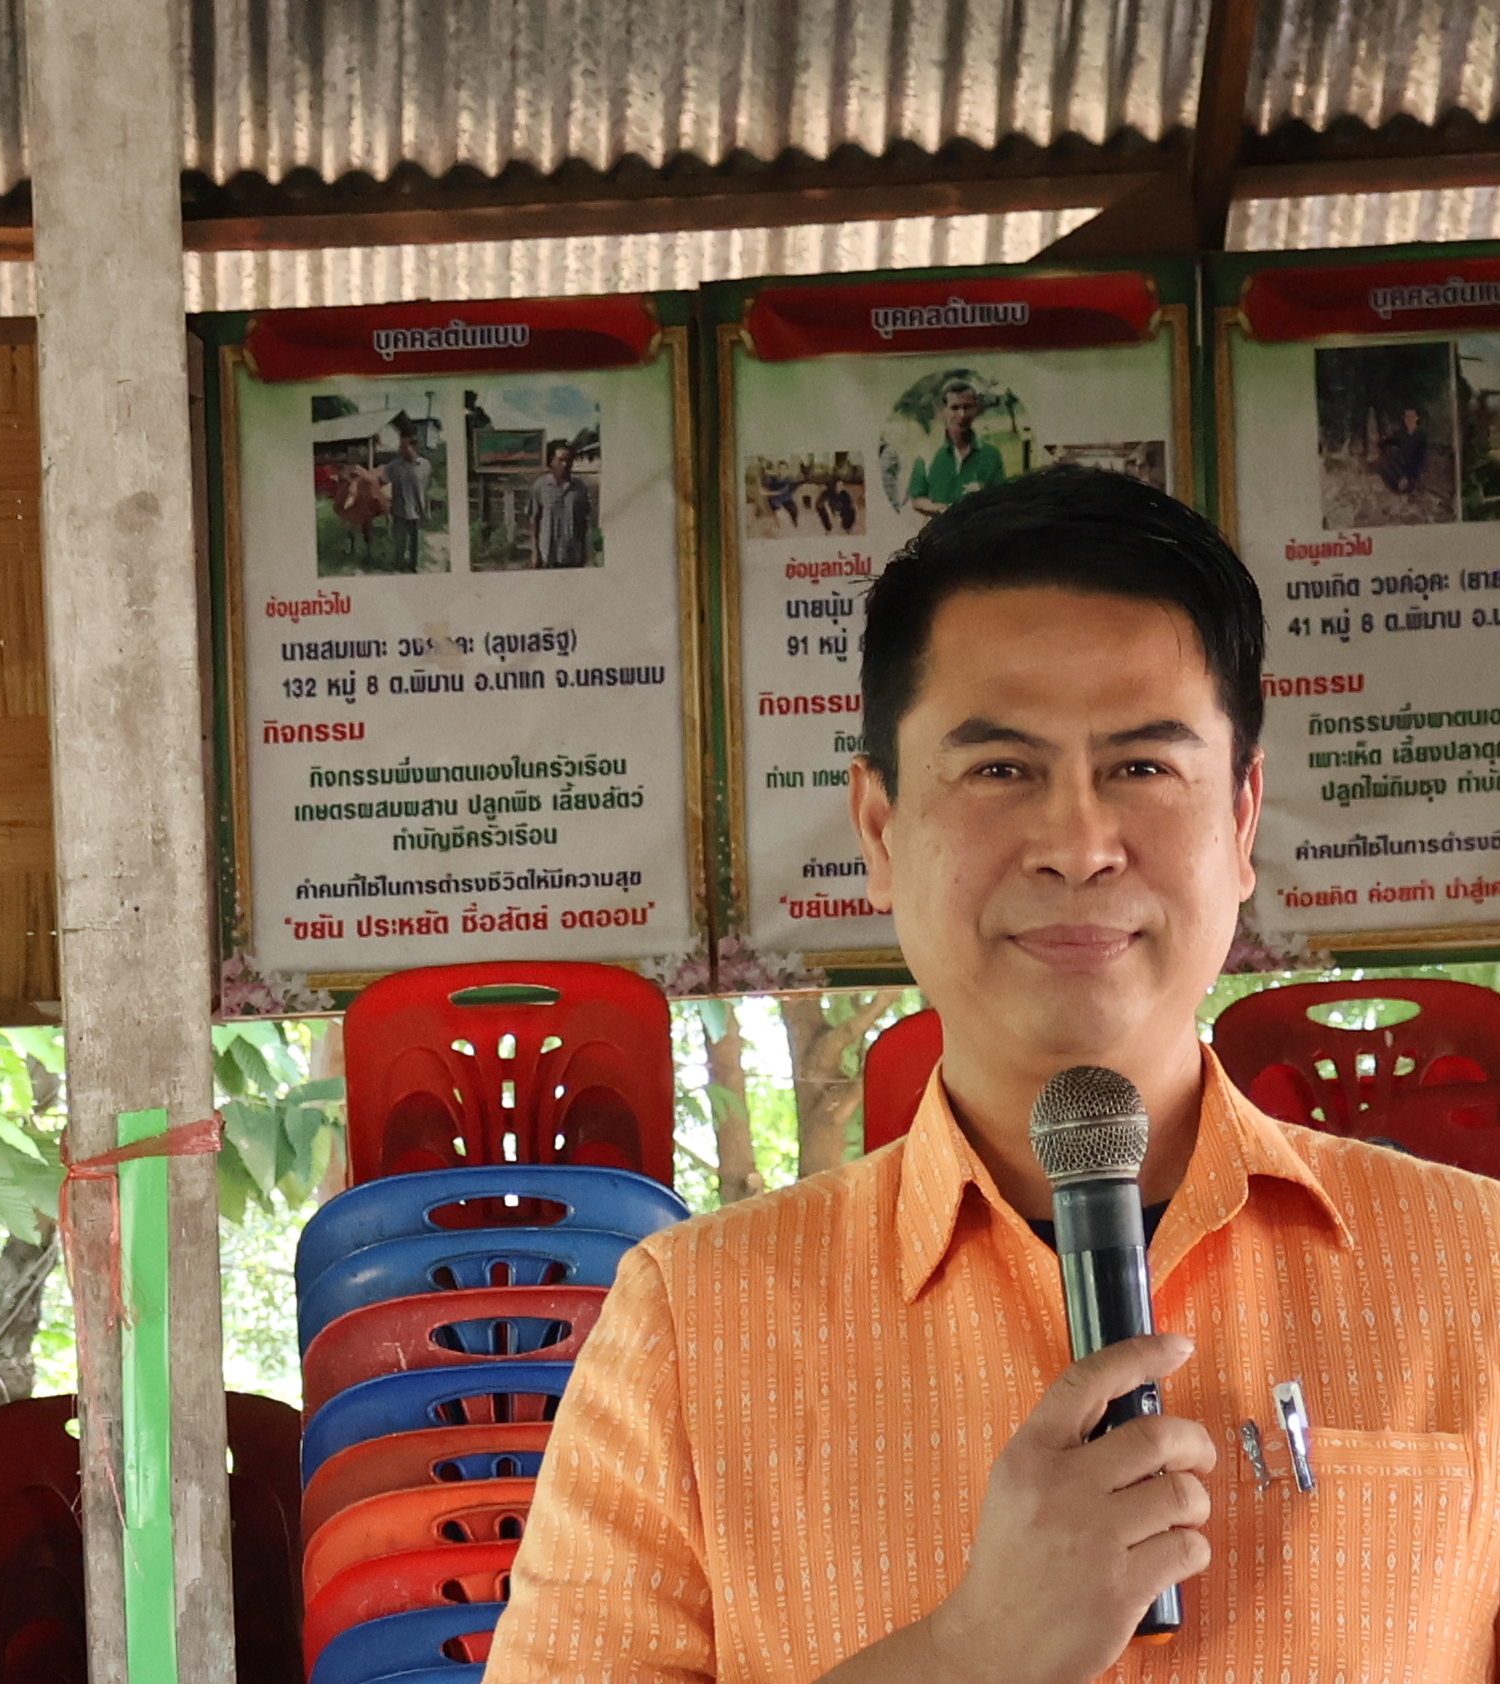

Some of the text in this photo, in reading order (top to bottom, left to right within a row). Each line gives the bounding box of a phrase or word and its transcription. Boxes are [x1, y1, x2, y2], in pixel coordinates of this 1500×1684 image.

[872, 298, 1030, 340] บุคคลต้นแบบ
[373, 319, 530, 361] บุคคลต้นแบบ
[266, 590, 352, 624] ข้อมูลทั่วไป
[1288, 616, 1311, 637] 41
[1321, 608, 1350, 643] หมู่
[1361, 613, 1374, 633] 8
[787, 636, 808, 656] 91
[820, 628, 847, 662] หมู่
[282, 677, 317, 699] 132
[328, 669, 357, 705] หมู่
[367, 674, 379, 696] 8
[475, 669, 546, 693] อ.นาแก
[556, 664, 666, 690] จ.นครพนม
[1262, 672, 1365, 699] กิจกรรม
[759, 691, 862, 716] กิจกรรม
[263, 718, 366, 745] กิจกรรม
[766, 765, 804, 789] ทำนา
[357, 907, 450, 938] ประหยัด
